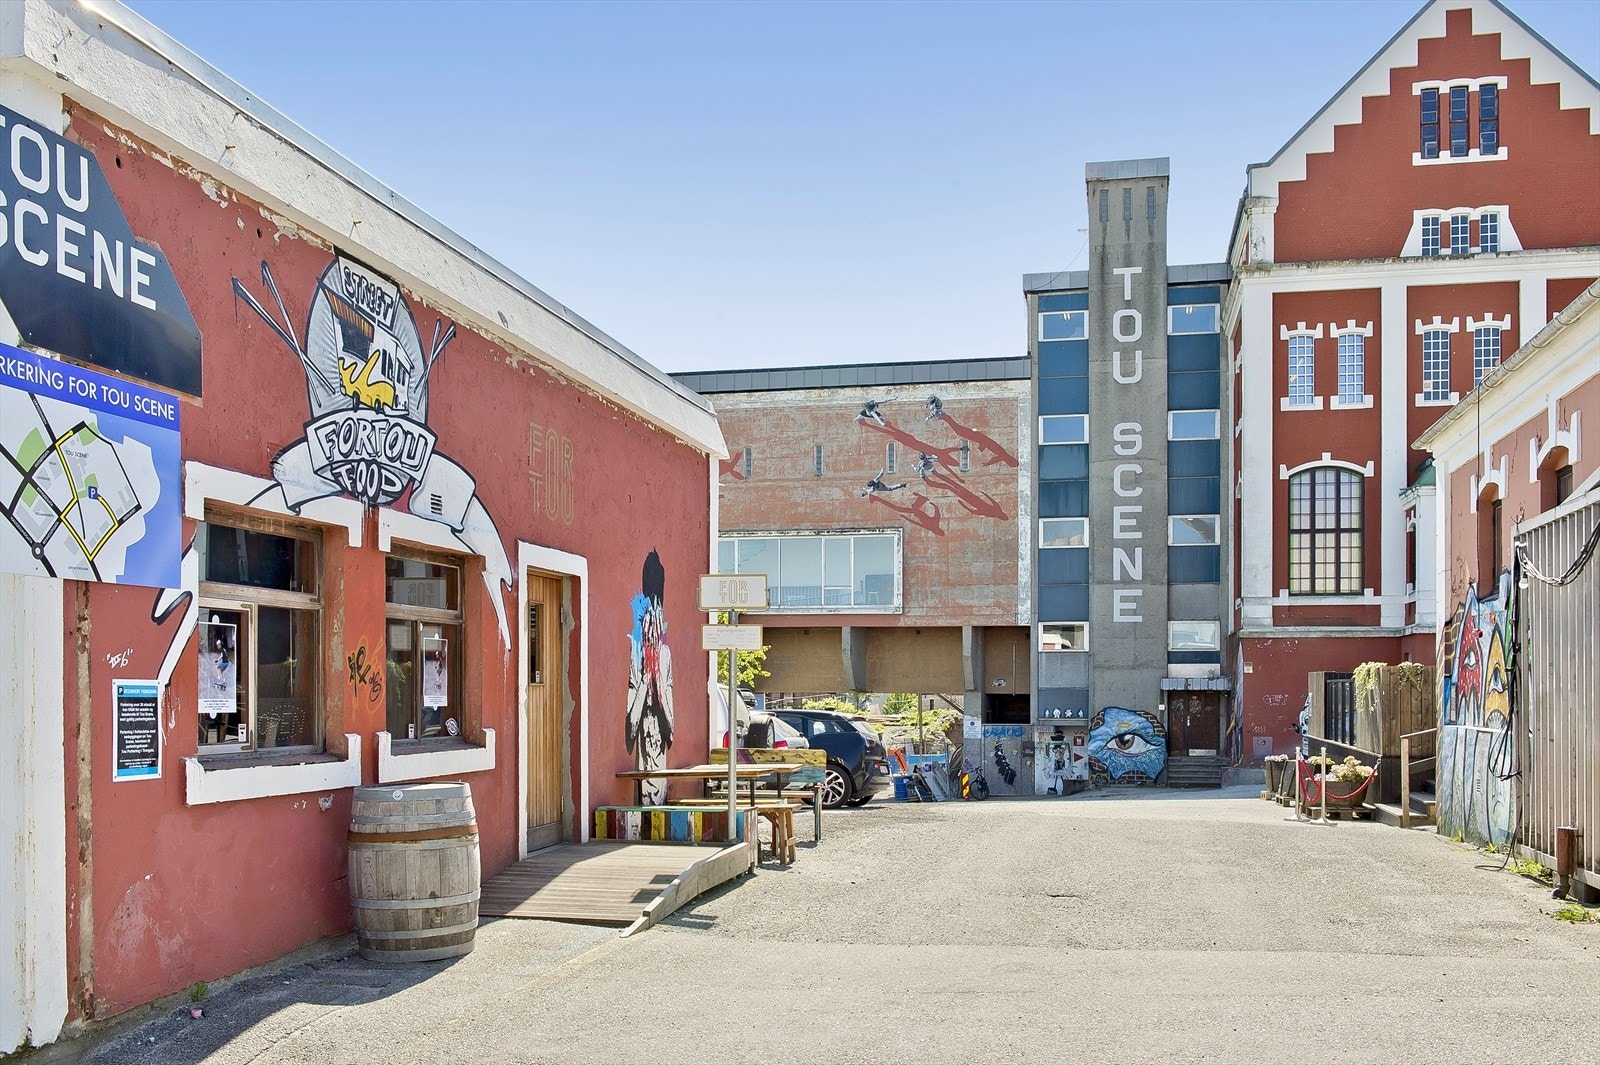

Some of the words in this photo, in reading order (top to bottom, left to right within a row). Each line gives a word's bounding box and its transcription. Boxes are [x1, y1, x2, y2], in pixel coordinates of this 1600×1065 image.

[0, 113, 89, 213] OU
[0, 189, 157, 311] CENE
[343, 266, 393, 321] STREET
[1113, 267, 1142, 384] TOU
[69, 376, 97, 400] FOR
[101, 385, 130, 408] TOU
[134, 395, 175, 421] SCENE
[315, 417, 427, 475] FORTOU
[332, 461, 403, 499] FOOD
[1113, 422, 1143, 623] SCENE
[719, 580, 749, 592] FOR
[719, 591, 749, 604] TOU
